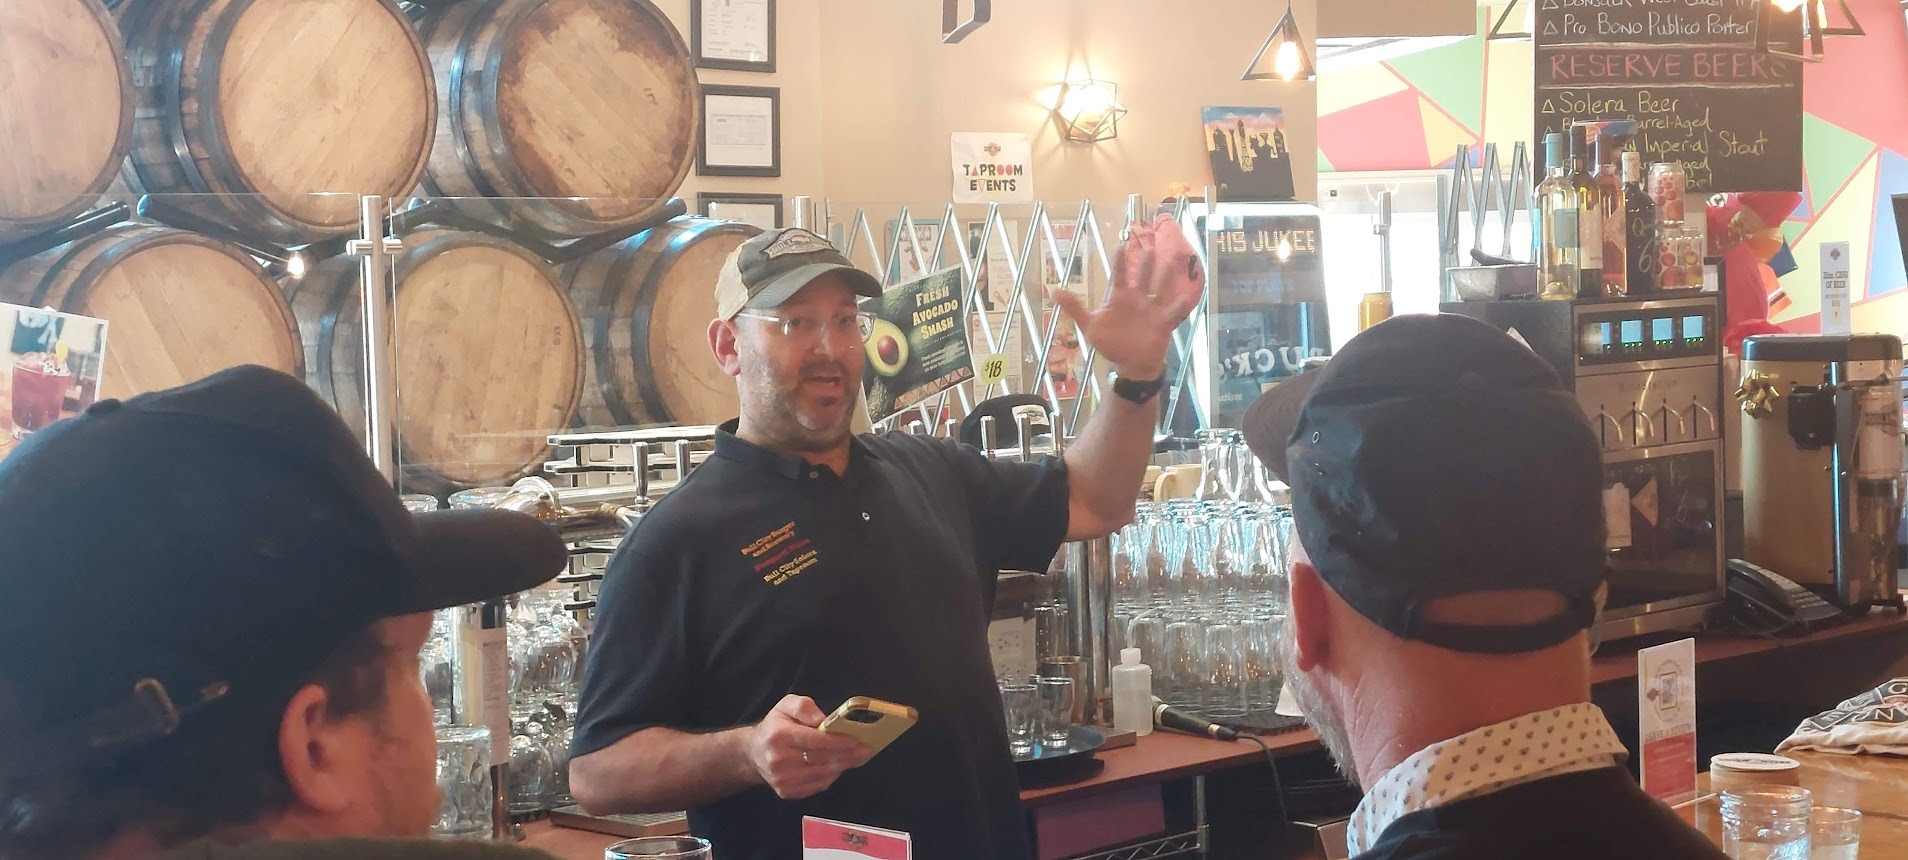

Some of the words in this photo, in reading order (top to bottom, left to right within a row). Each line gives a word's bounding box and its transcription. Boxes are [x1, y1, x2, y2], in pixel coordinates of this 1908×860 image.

[1564, 13, 1587, 36] Pro
[1648, 11, 1700, 36] Publico
[1707, 13, 1755, 35] Porter
[1550, 53, 1682, 79] RESERVE
[1559, 91, 1627, 114] Solera
[1638, 91, 1680, 113] Beer
[1645, 133, 1709, 163] Imperial
[1718, 130, 1769, 157] Stout
[963, 164, 1023, 176] TAPROOM
[970, 179, 1016, 192] EVENTS
[915, 285, 949, 307] FRESH
[912, 299, 958, 326] AVOCADO
[921, 316, 954, 340] SMASH
[985, 360, 1002, 378] $18
